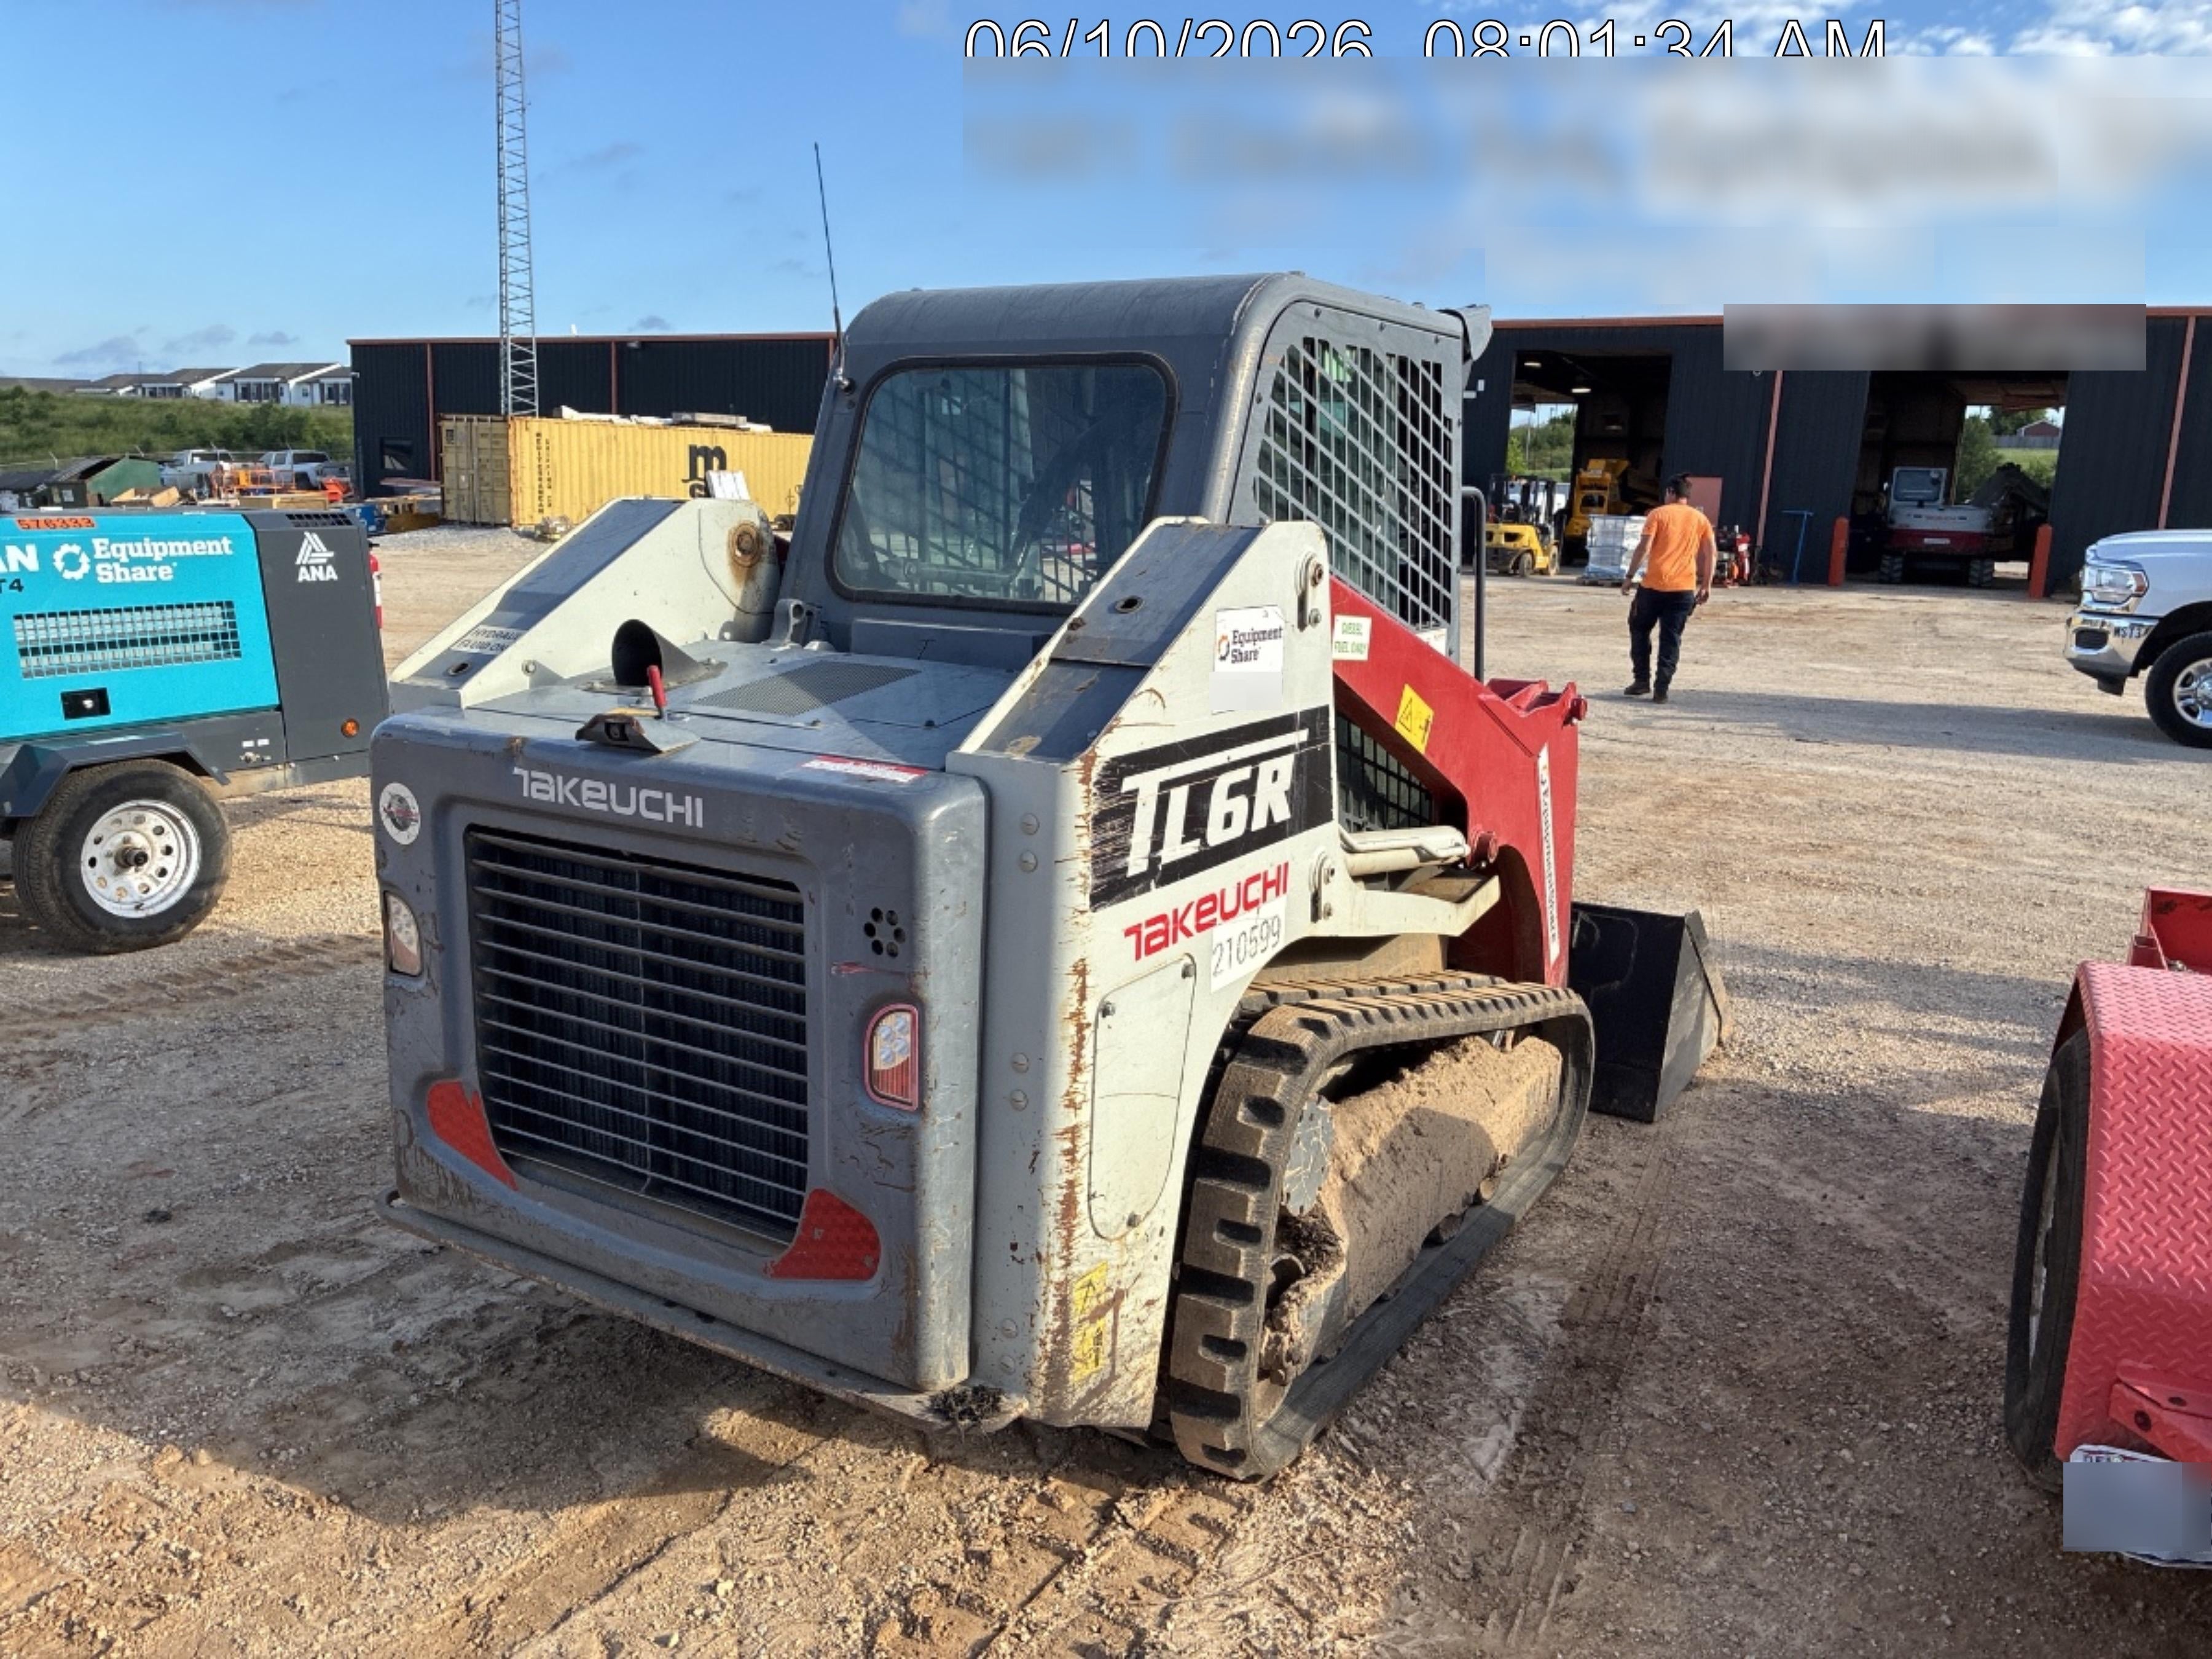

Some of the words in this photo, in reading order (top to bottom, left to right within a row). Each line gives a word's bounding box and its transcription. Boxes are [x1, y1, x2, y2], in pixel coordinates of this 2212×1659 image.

[0, 544, 40, 573] N
[92, 536, 233, 563] Equipment
[95, 562, 174, 583] Share
[297, 564, 338, 582] ANA
[1232, 626, 1283, 648] Equipment
[1231, 648, 1260, 664] Share
[1120, 728, 1309, 878] TL6R
[1212, 915, 1282, 977] 210599
